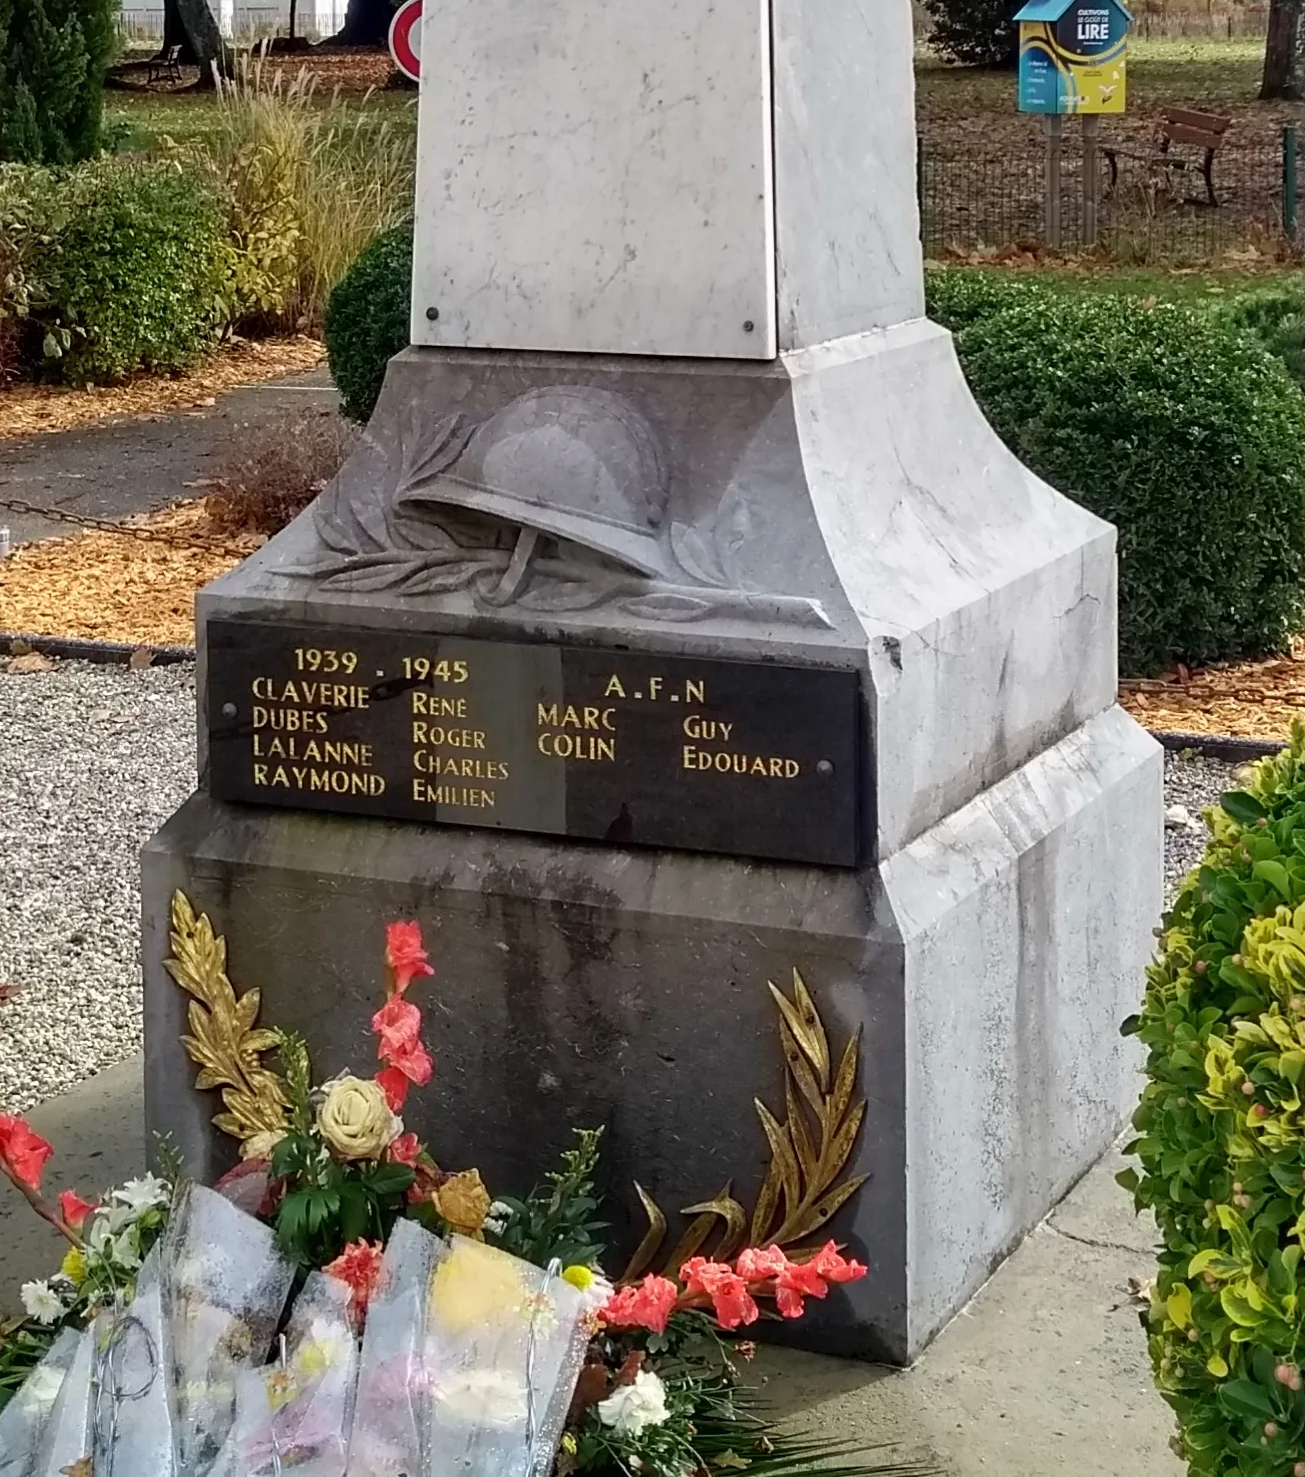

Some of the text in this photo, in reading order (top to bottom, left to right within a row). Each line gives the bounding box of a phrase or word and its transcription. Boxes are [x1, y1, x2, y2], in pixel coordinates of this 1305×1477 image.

[1077, 23, 1109, 40] LIRE
[294, 648, 358, 674] 1939
[402, 657, 469, 683] 1945
[252, 677, 370, 709] CLAVERIE
[253, 706, 485, 749] DUBES ROGER
[538, 703, 733, 741] MARC GUY
[253, 734, 509, 780] LALANNE CHARLES
[538, 732, 799, 778] COLIN EDOUARD
[254, 764, 496, 808] RAYMOND EMILIEN
